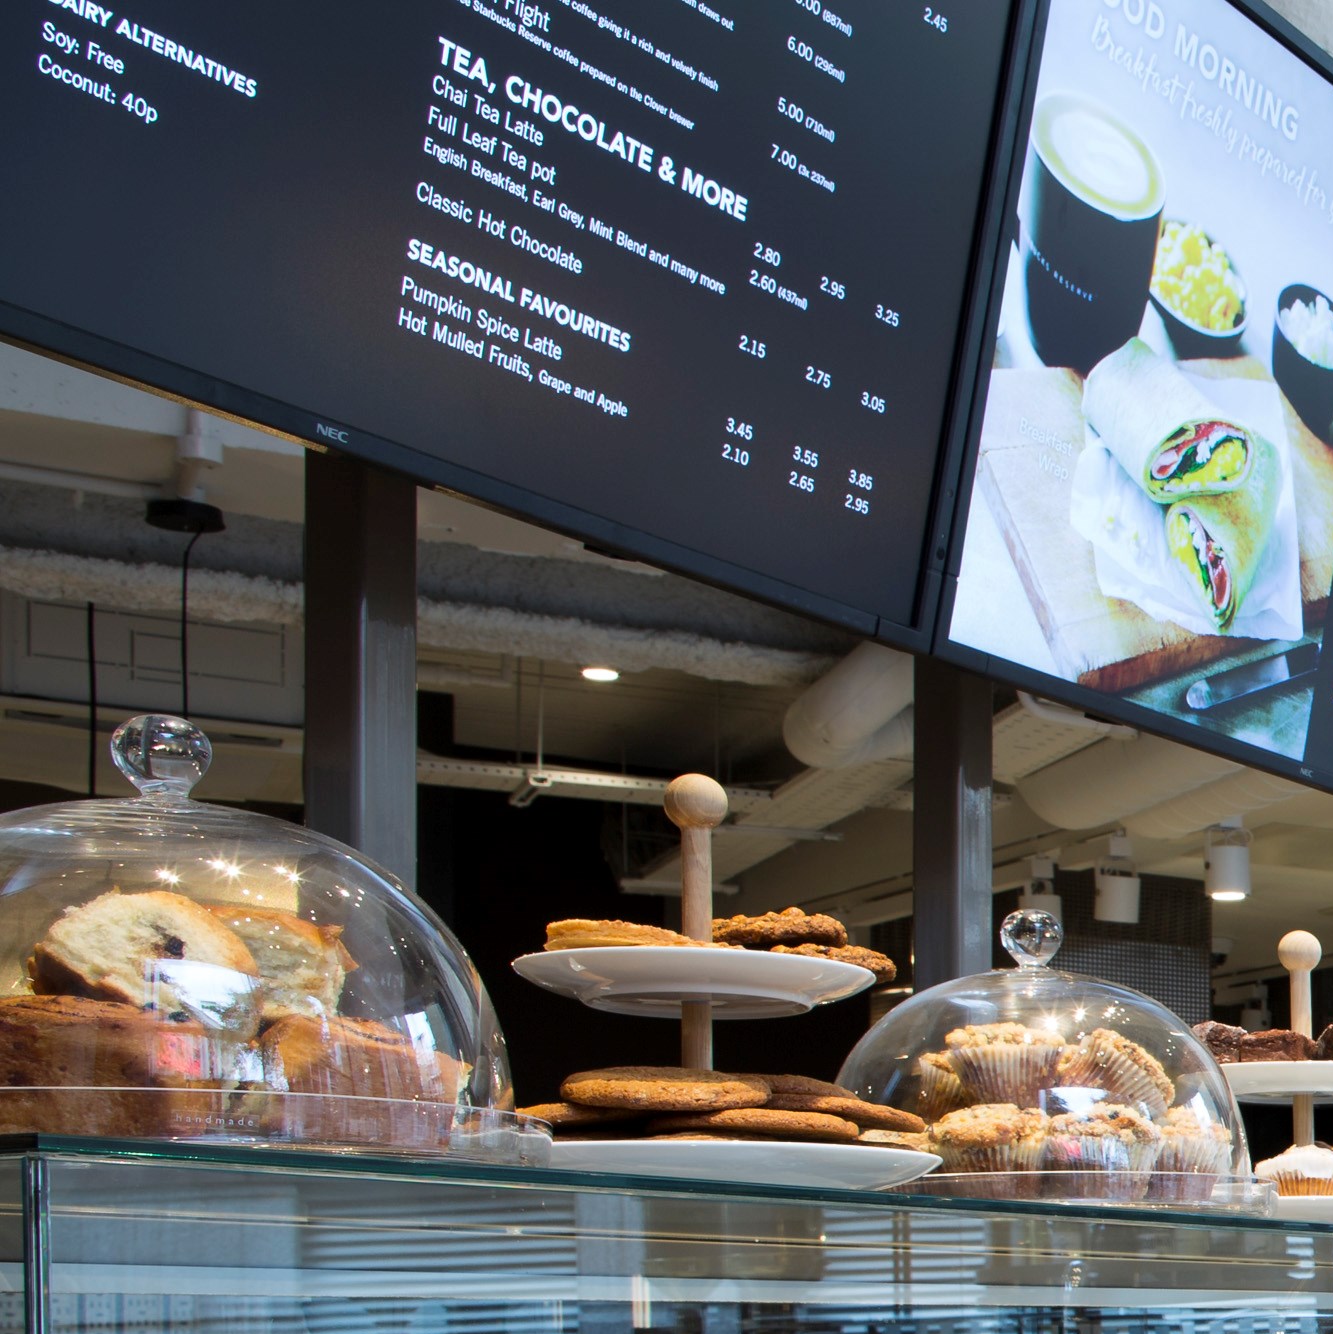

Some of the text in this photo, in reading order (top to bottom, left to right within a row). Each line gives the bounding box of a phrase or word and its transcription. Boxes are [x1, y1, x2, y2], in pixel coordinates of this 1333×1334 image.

[43, 22, 124, 74] Soy: Free
[49, 0, 256, 97] AIRY ALTERNATIVES
[505, 0, 550, 32] Flight
[571, 1, 597, 21] coffee
[598, 17, 622, 38] giving
[624, 29, 630, 40] it
[631, 36, 637, 44] a
[638, 39, 653, 54] rich
[655, 49, 671, 63] and
[672, 58, 697, 80] velvety
[699, 72, 718, 91] finish
[698, 3, 720, 22] draws
[721, 18, 733, 31] out
[822, 9, 853, 37] (887ml)
[923, 7, 948, 33] 2.45
[38, 54, 157, 123] Coconut: 40p
[473, 0, 516, 32] Starbucks
[518, 23, 551, 51] Reserve
[553, 47, 579, 66] coffee
[580, 62, 616, 87] prepared
[617, 82, 628, 94] on
[630, 87, 642, 102] the
[644, 95, 668, 115] Clover
[669, 108, 694, 129] brewer
[787, 35, 846, 83] 6.00 (296ml)
[1174, 23, 1300, 141] MORNING
[439, 37, 747, 221] TEA, CHOCOLATE & MORE
[777, 96, 835, 143] 5.00 (710ml)
[1091, 14, 1185, 104] Breakfast
[1181, 81, 1238, 151] freshly
[1239, 135, 1307, 197] prepared
[1304, 170, 1326, 210] for
[428, 106, 808, 310] Full Leaf Tea pot 2.60 (437ml)
[433, 75, 900, 327] Chai Tea Latte 2.80 2.95 3.25
[771, 144, 797, 170] 7.00
[810, 170, 836, 193] 237ml)
[424, 137, 725, 294] English Breakfast, Earl Grey, Mint Blend and many more
[407, 239, 630, 351] SEASONAL FAVOURITES
[417, 182, 886, 414] Classic Hot Chocolate 2.15 2.75 3.05
[399, 307, 869, 515] Hot Mulled Fruits, Grape and Apple 2.10 2.65 2.95
[401, 276, 873, 491] Pumpkin Spice Latte 3.45 3.55 3.85
[316, 422, 349, 444] NEC
[1019, 416, 1073, 457] Breakfast
[1038, 452, 1070, 481] Wrap
[176, 1113, 254, 1126] handmade
